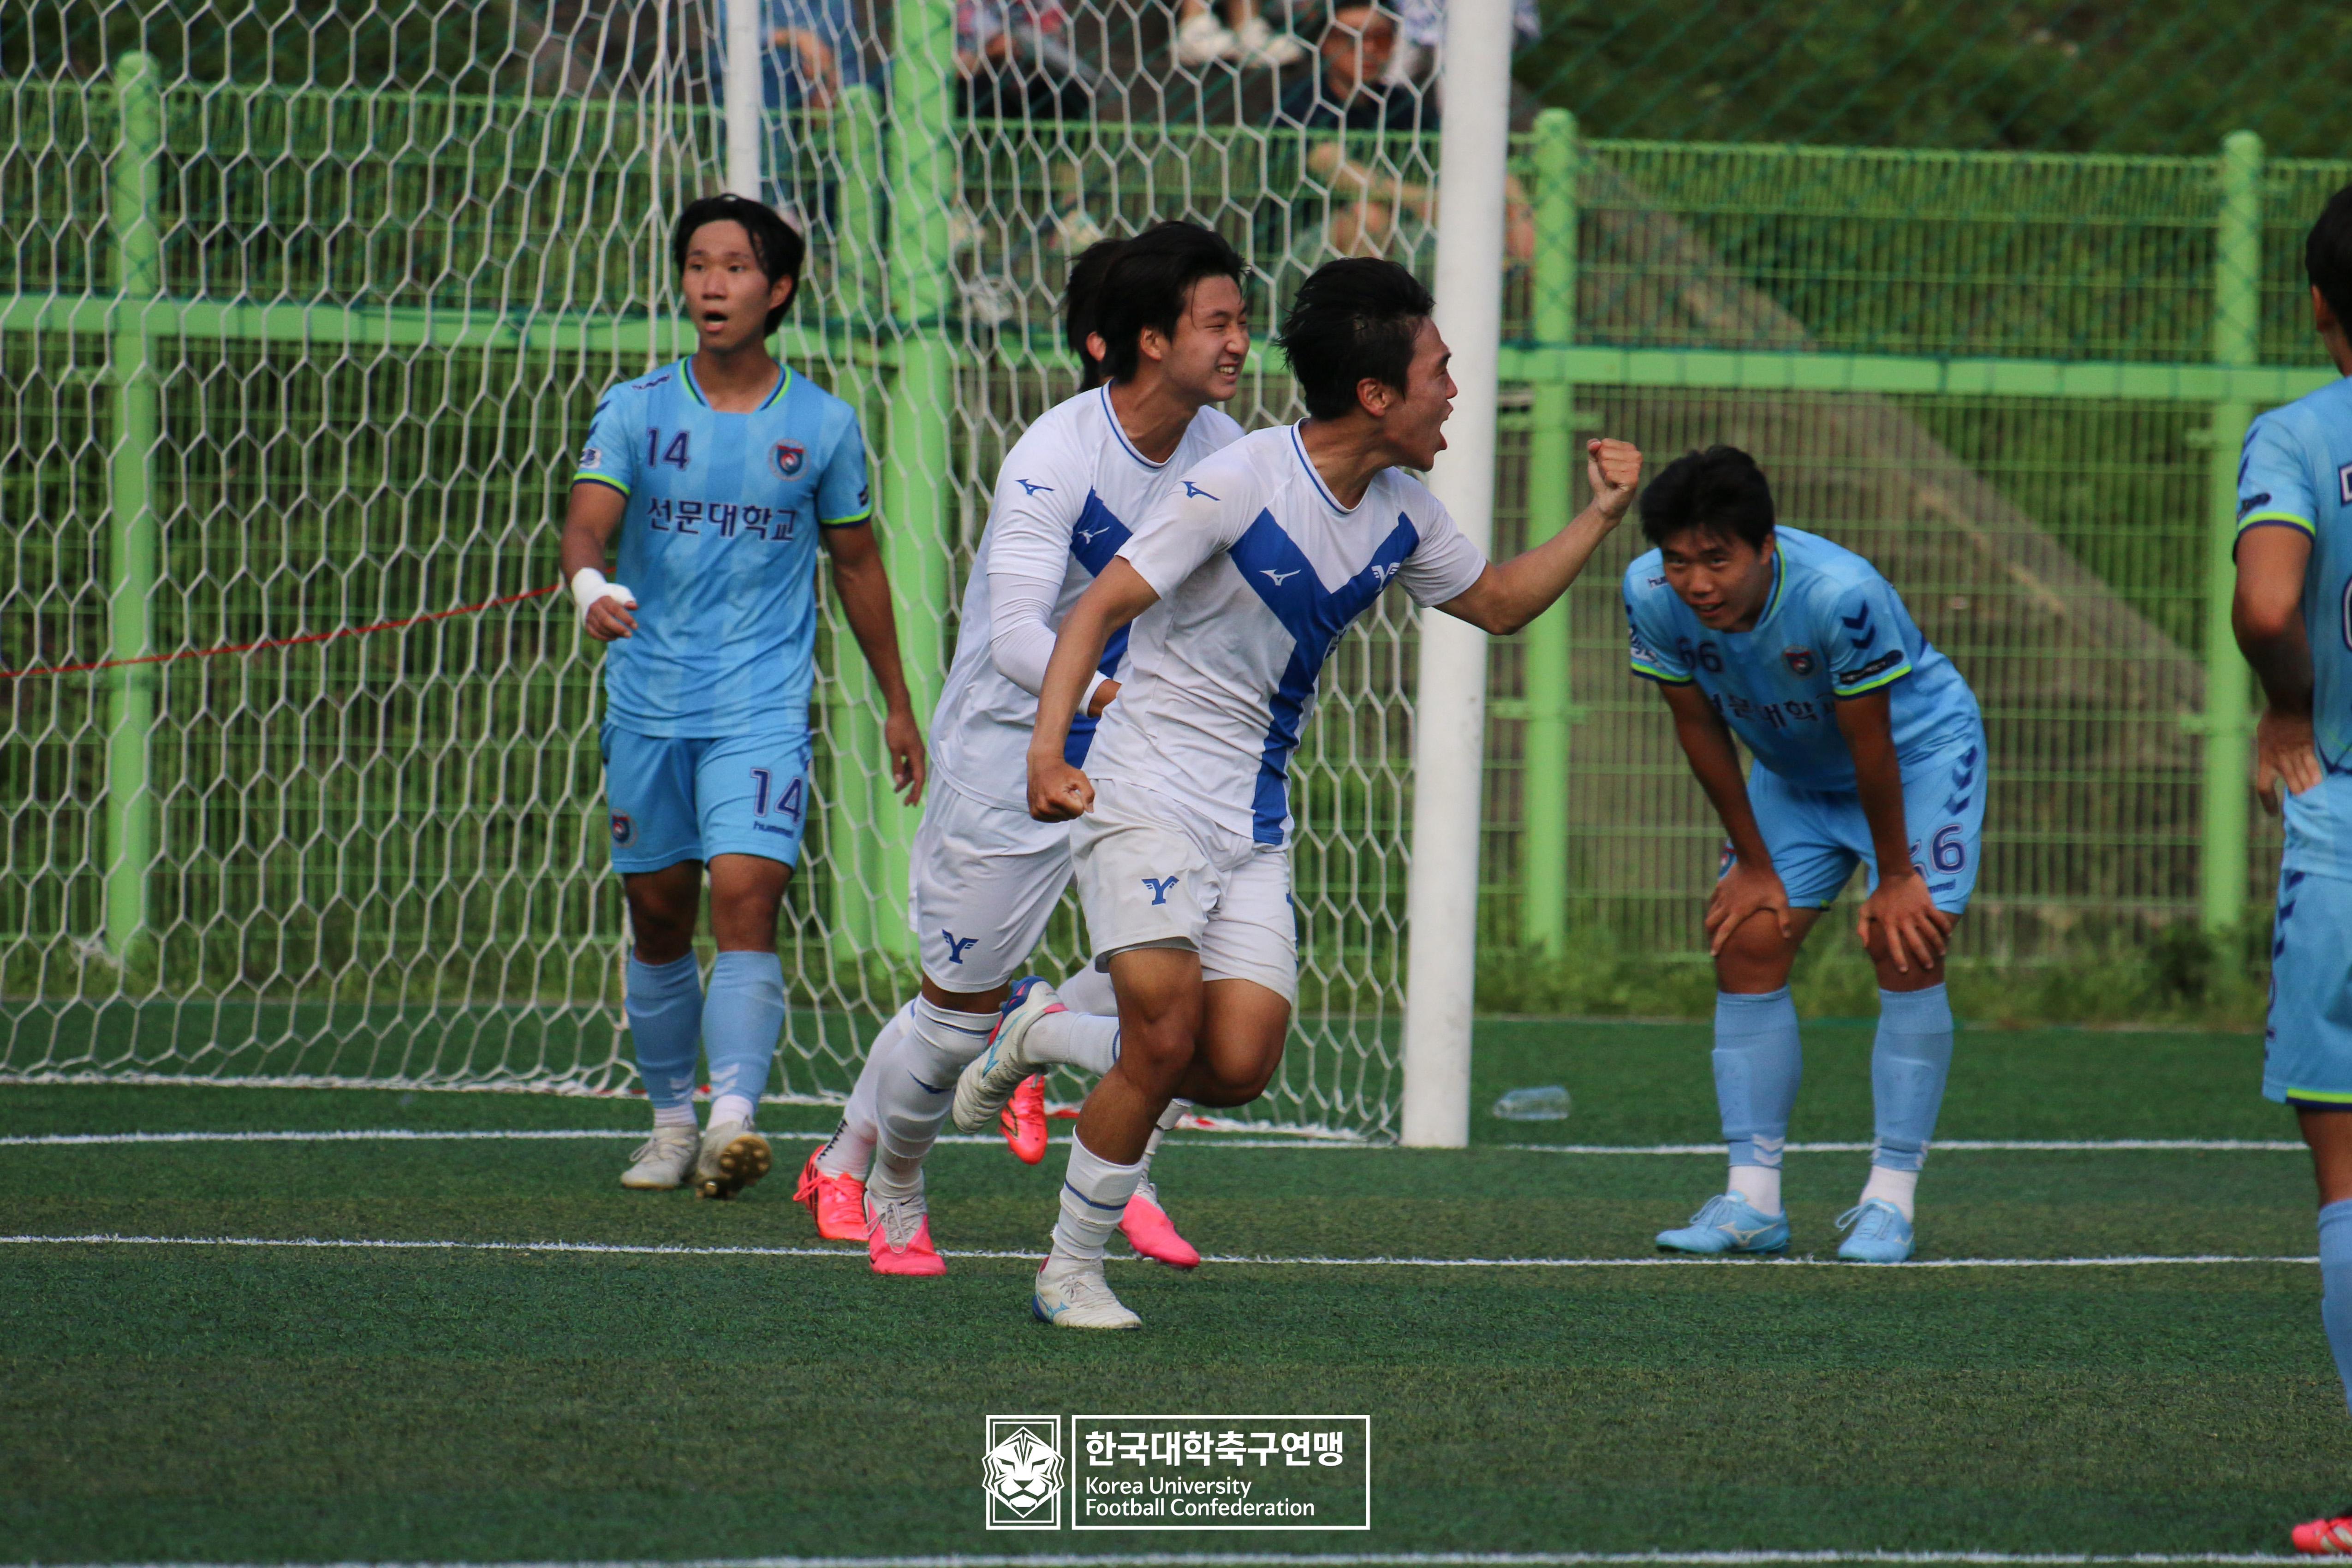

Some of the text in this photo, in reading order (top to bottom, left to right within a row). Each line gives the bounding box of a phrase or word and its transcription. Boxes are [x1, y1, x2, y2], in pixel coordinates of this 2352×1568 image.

[647, 427, 690, 471] 14
[647, 497, 798, 541] 선문대학교
[1676, 636, 1725, 674] 66
[750, 767, 802, 826] 14
[1909, 823, 1965, 875] 6
[1141, 875, 1179, 906] Y
[941, 928, 980, 965] Y
